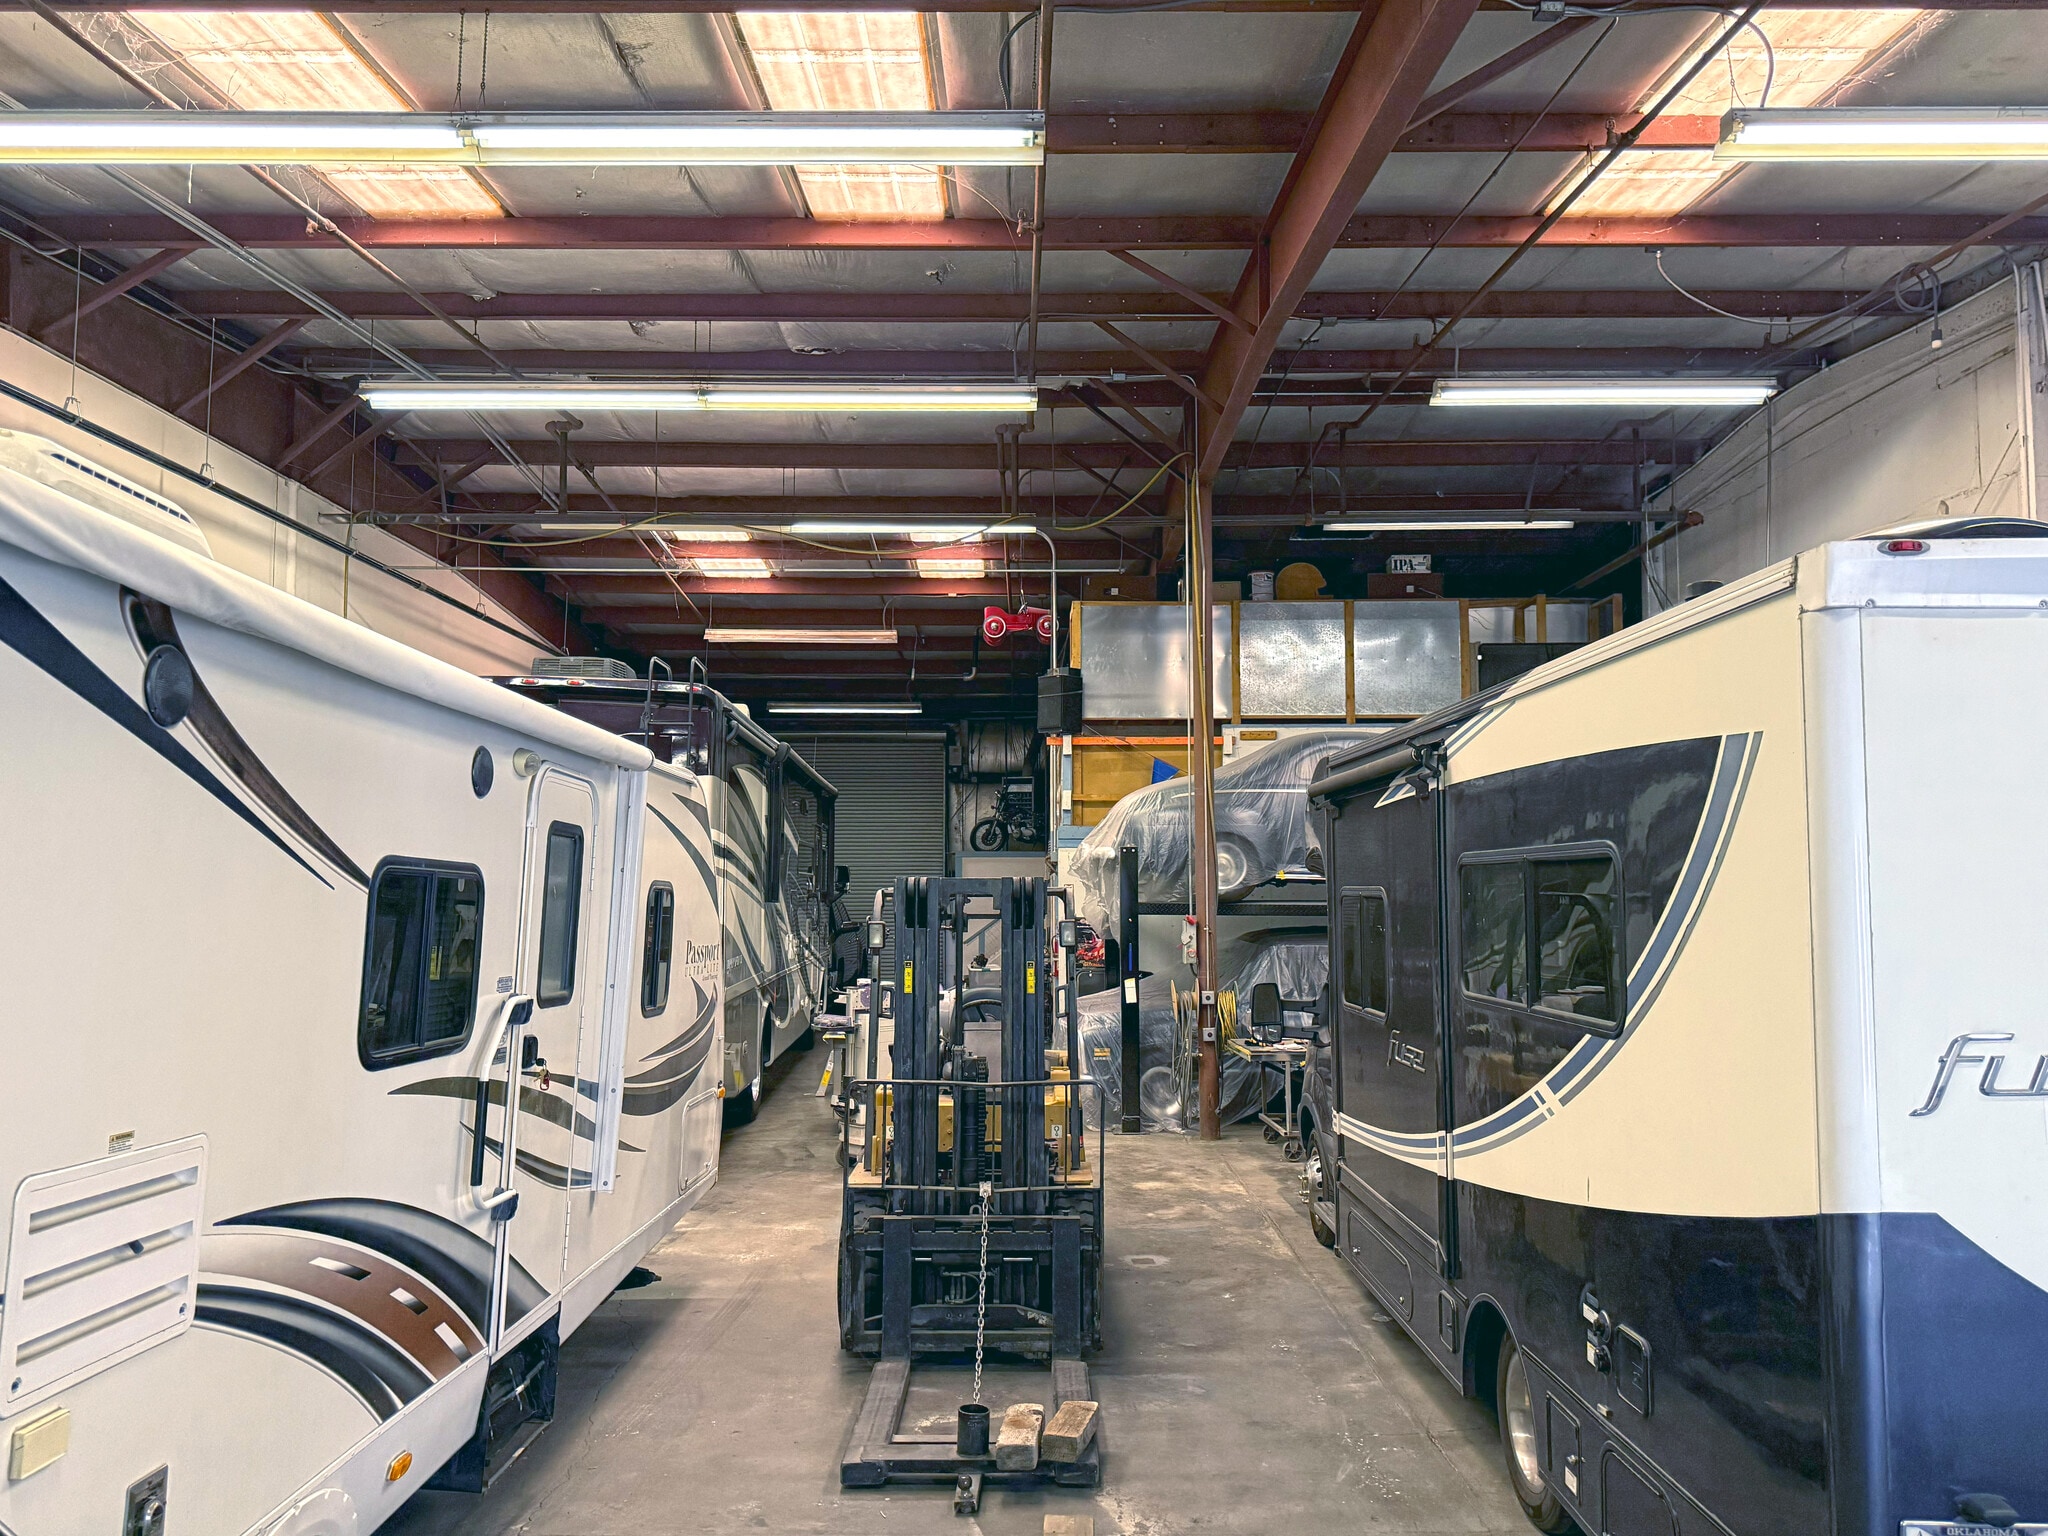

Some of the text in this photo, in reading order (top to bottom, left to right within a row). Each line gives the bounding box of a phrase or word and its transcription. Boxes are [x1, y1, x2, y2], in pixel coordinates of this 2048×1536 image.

[1393, 559, 1416, 571] IPA
[685, 940, 720, 969] Passport
[1946, 1526, 2020, 1536] OKLAHOMA
